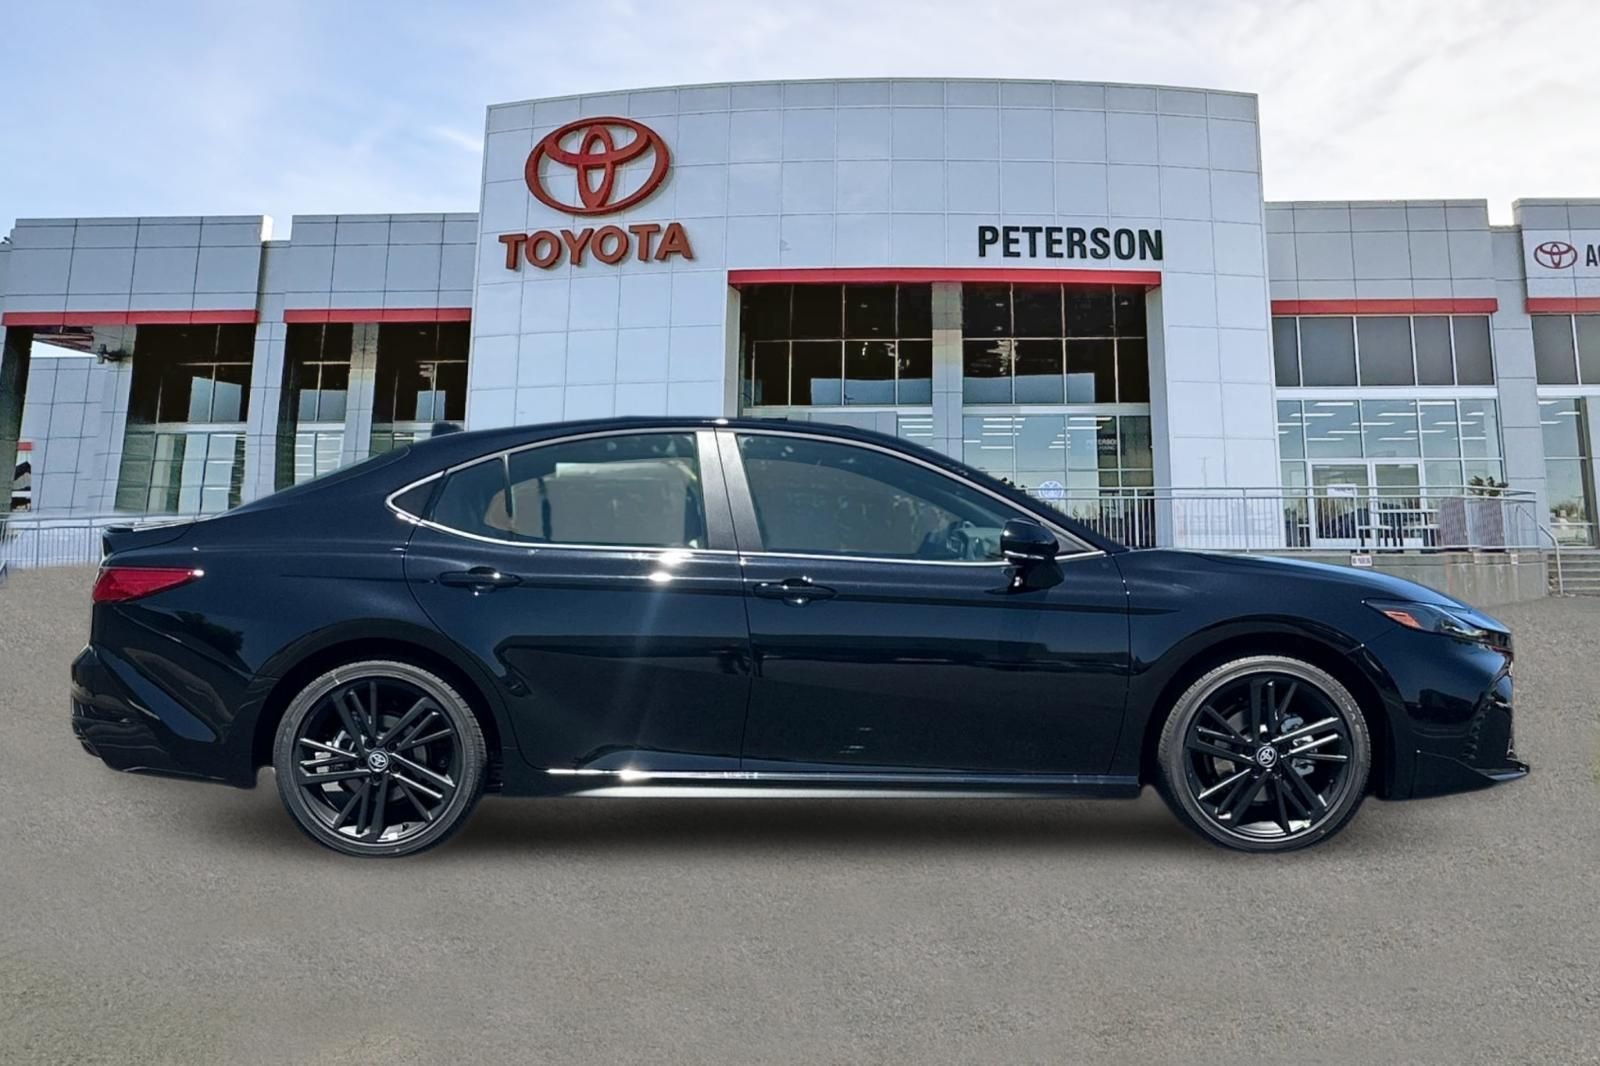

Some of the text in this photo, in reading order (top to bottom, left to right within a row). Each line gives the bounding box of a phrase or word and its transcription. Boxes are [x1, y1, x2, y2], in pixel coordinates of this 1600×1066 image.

[499, 222, 693, 270] TOYOTA
[978, 225, 1163, 261] PETERSON
[1586, 244, 1600, 267] A
